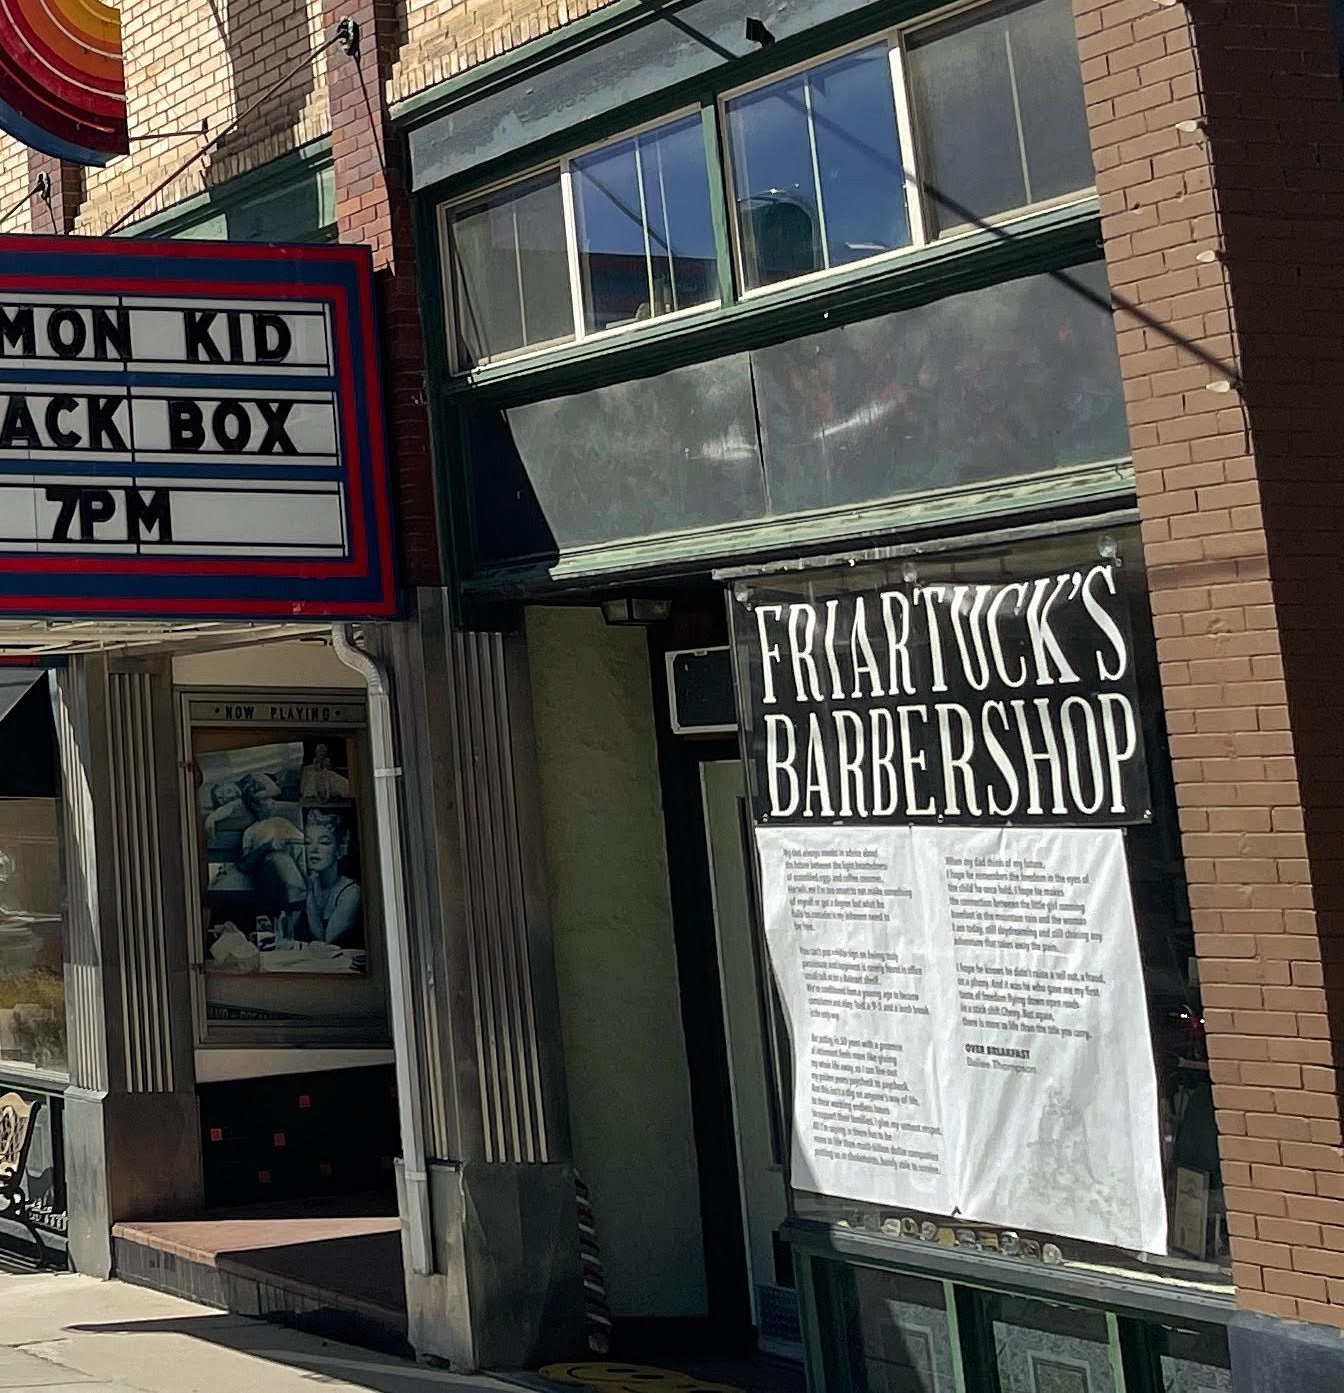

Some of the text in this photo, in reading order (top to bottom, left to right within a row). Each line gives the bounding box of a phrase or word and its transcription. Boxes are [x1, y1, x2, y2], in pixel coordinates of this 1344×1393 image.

[185, 310, 293, 365] KID
[169, 400, 299, 456] BOX
[44, 487, 173, 543] 7PM
[753, 564, 1127, 704] FRIARTUCK'S
[225, 704, 331, 721] NOW PLAYING
[763, 691, 1137, 819] BARBERSHOP
[965, 1043, 1030, 1059] OVER BREAKFAST
[992, 1059, 1036, 1073] Thompson
